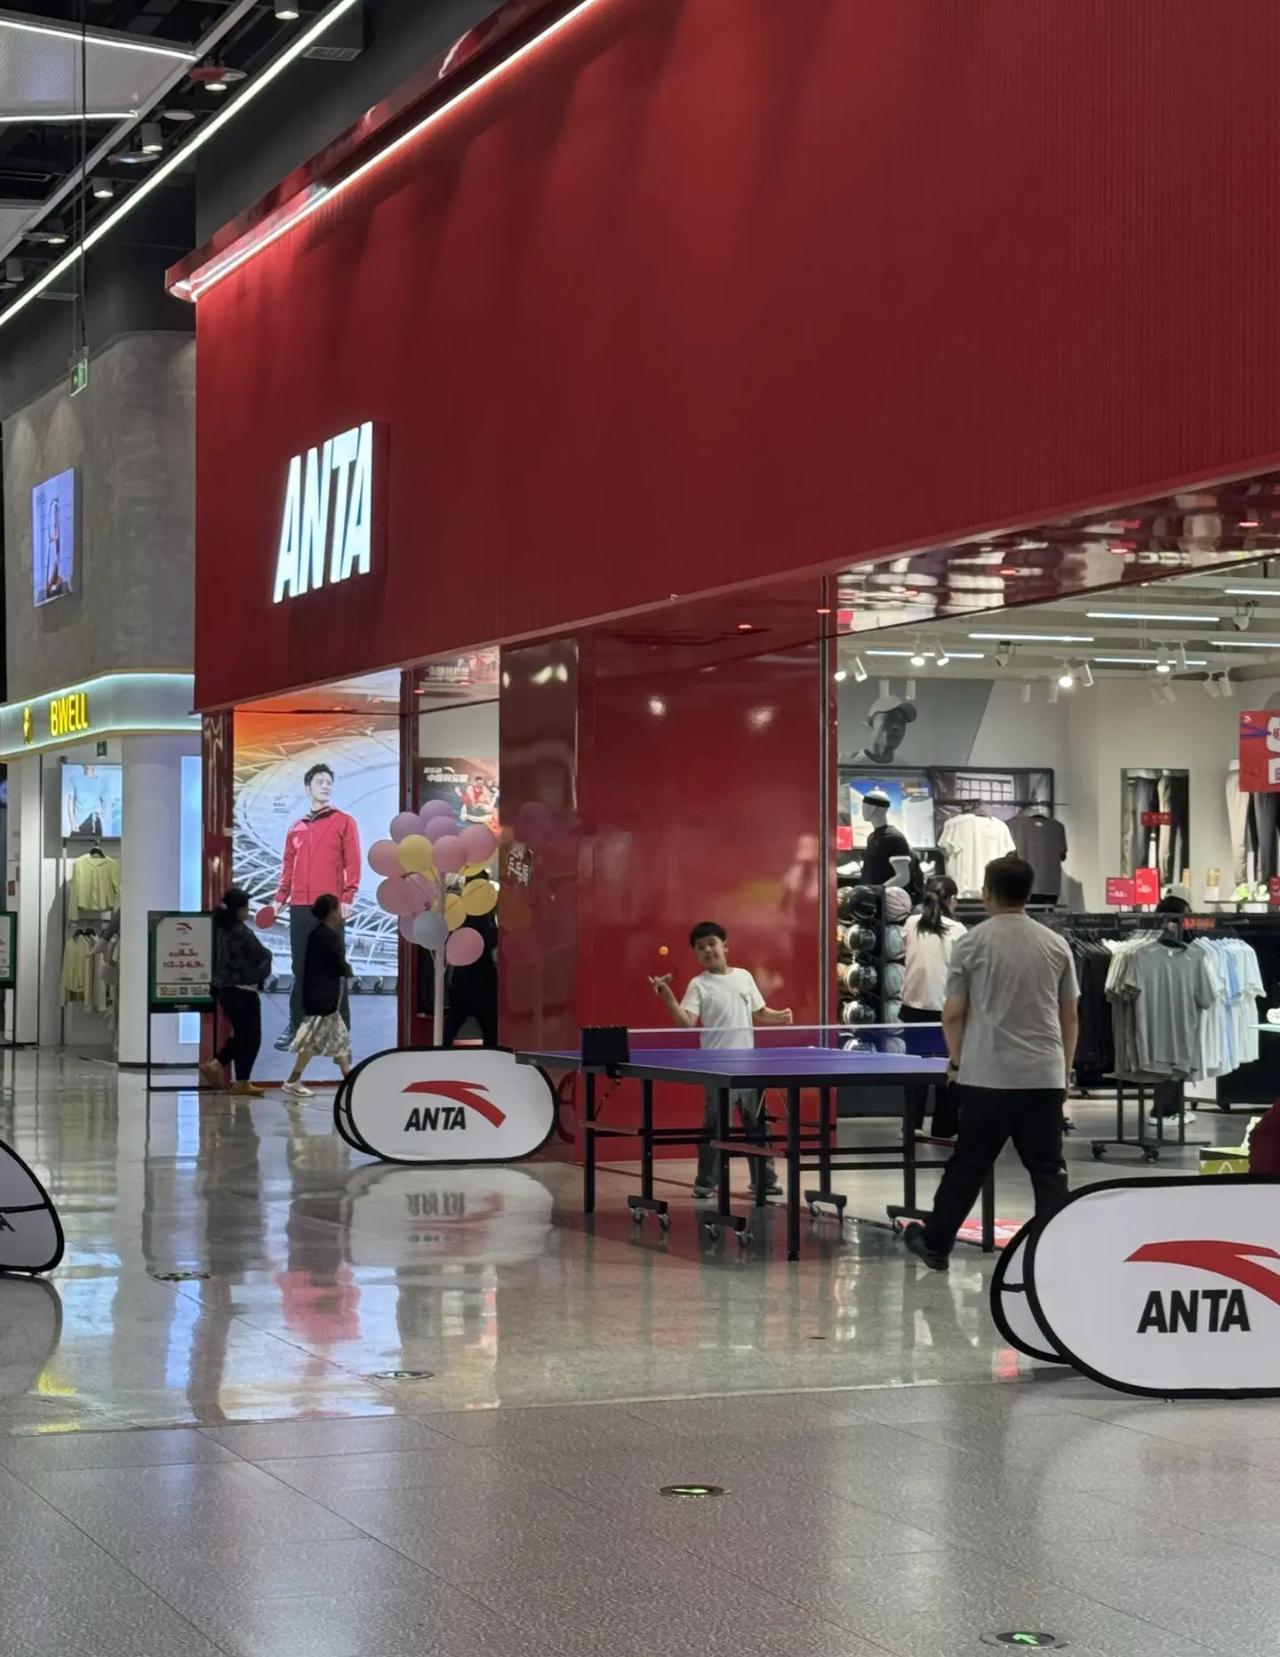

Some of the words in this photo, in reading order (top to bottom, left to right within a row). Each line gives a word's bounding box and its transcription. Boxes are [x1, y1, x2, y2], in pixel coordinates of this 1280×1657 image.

[273, 421, 373, 603] ANTA
[50, 693, 88, 736] BWELL
[404, 1106, 466, 1131] ANTA
[1137, 1289, 1251, 1333] ANTA
